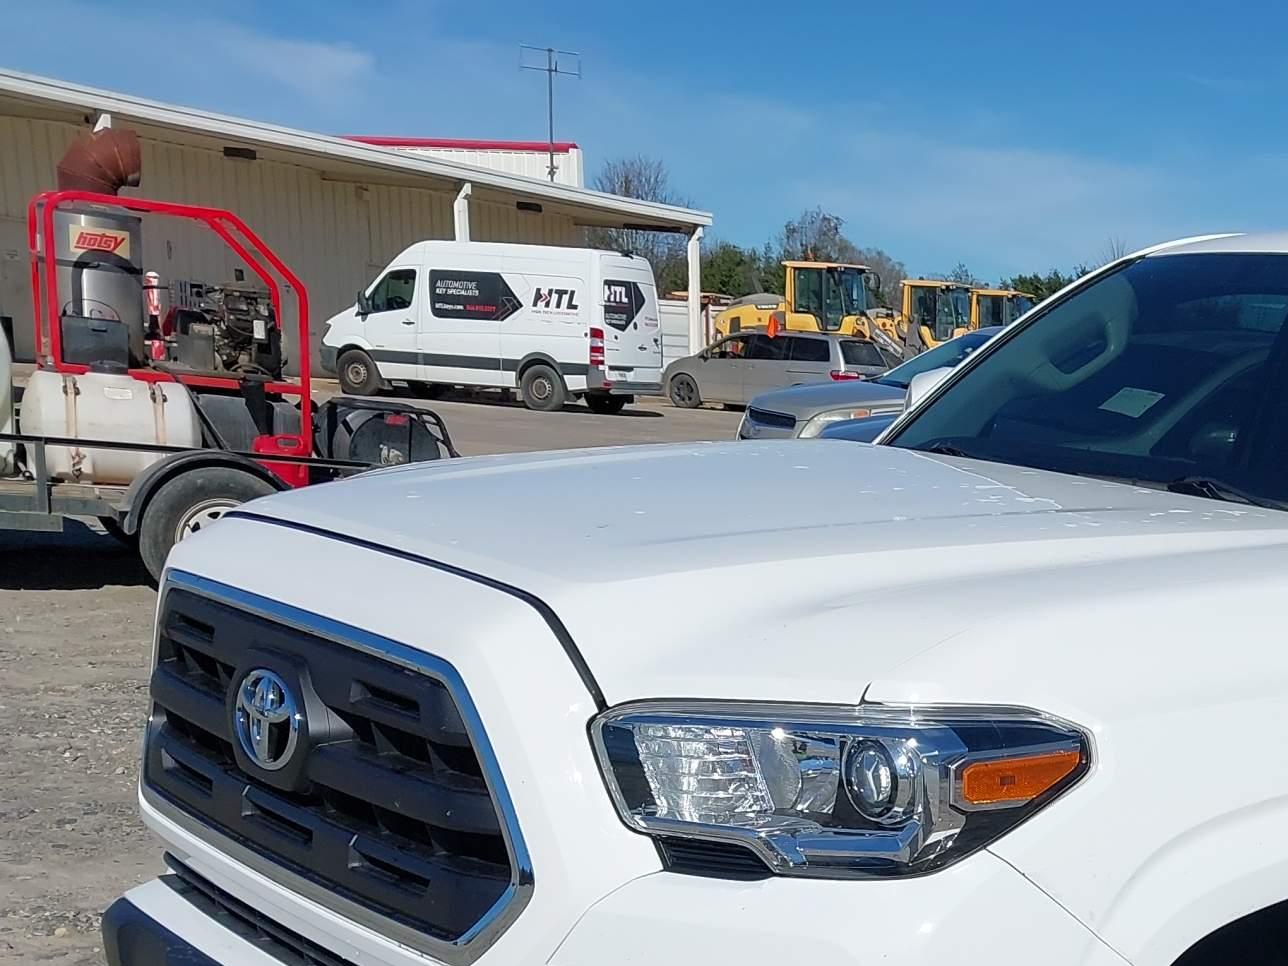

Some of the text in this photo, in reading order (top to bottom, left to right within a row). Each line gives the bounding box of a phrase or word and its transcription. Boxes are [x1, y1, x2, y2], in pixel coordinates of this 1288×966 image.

[75, 232, 126, 252] hotsy
[435, 280, 478, 290] AUTOMOTIVE
[447, 288, 479, 297] SPECIALISTS
[604, 284, 629, 303] HTL
[532, 287, 579, 310] HTL
